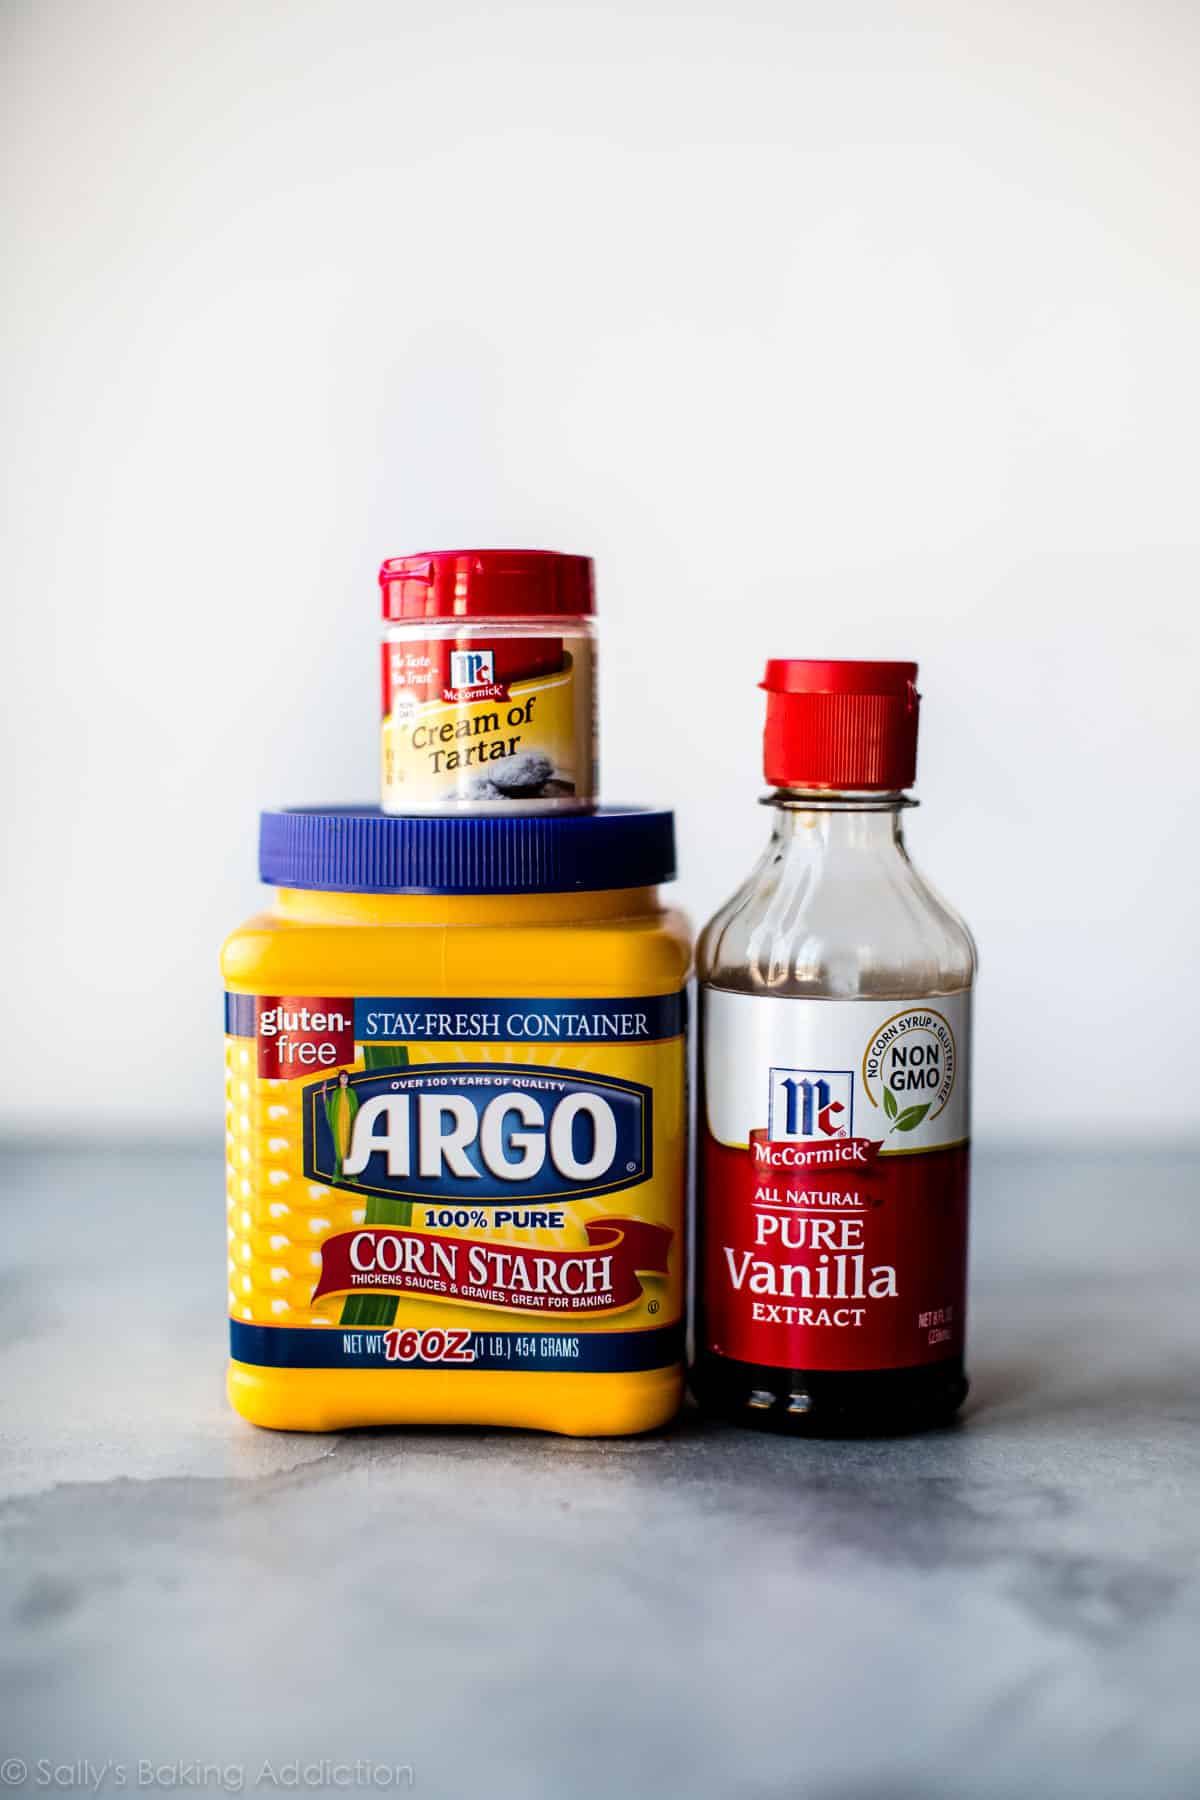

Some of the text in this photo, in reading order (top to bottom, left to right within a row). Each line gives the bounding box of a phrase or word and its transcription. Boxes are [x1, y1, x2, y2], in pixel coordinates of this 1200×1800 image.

[411, 697, 536, 750] Cream of
[428, 735, 521, 774] Tartar
[259, 1006, 352, 1036] gluten-
[366, 1012, 649, 1038] STAY-FRESH CONTAINER
[898, 1015, 932, 1032] SYRUP
[275, 1036, 338, 1064] free
[872, 1025, 898, 1057] CORN
[891, 1044, 939, 1067] NON
[867, 1059, 879, 1079] NO
[890, 1068, 940, 1091] GMO
[391, 1077, 566, 1091] OVER 100 YEARS OF QUALITY
[343, 1091, 618, 1181] ARGO
[753, 1142, 867, 1166] McCormick
[755, 1187, 863, 1206] ALL NATURAL
[425, 1210, 565, 1229] 100% PURE
[755, 1213, 865, 1250] PURE
[349, 1232, 614, 1295] CORN STARCH
[723, 1246, 899, 1299] Vanilla
[350, 1273, 403, 1287] THICKENS
[405, 1275, 447, 1292] SAUCES
[449, 1282, 459, 1294] &
[512, 1293, 545, 1307] GREAT
[548, 1296, 569, 1309] FOR
[572, 1294, 616, 1309] BAKING.
[751, 1302, 867, 1328] EXTRACT
[343, 1334, 362, 1354] NET
[489, 1337, 512, 1360] LB.)
[515, 1338, 536, 1358] 454
[540, 1337, 579, 1358] GRAMS
